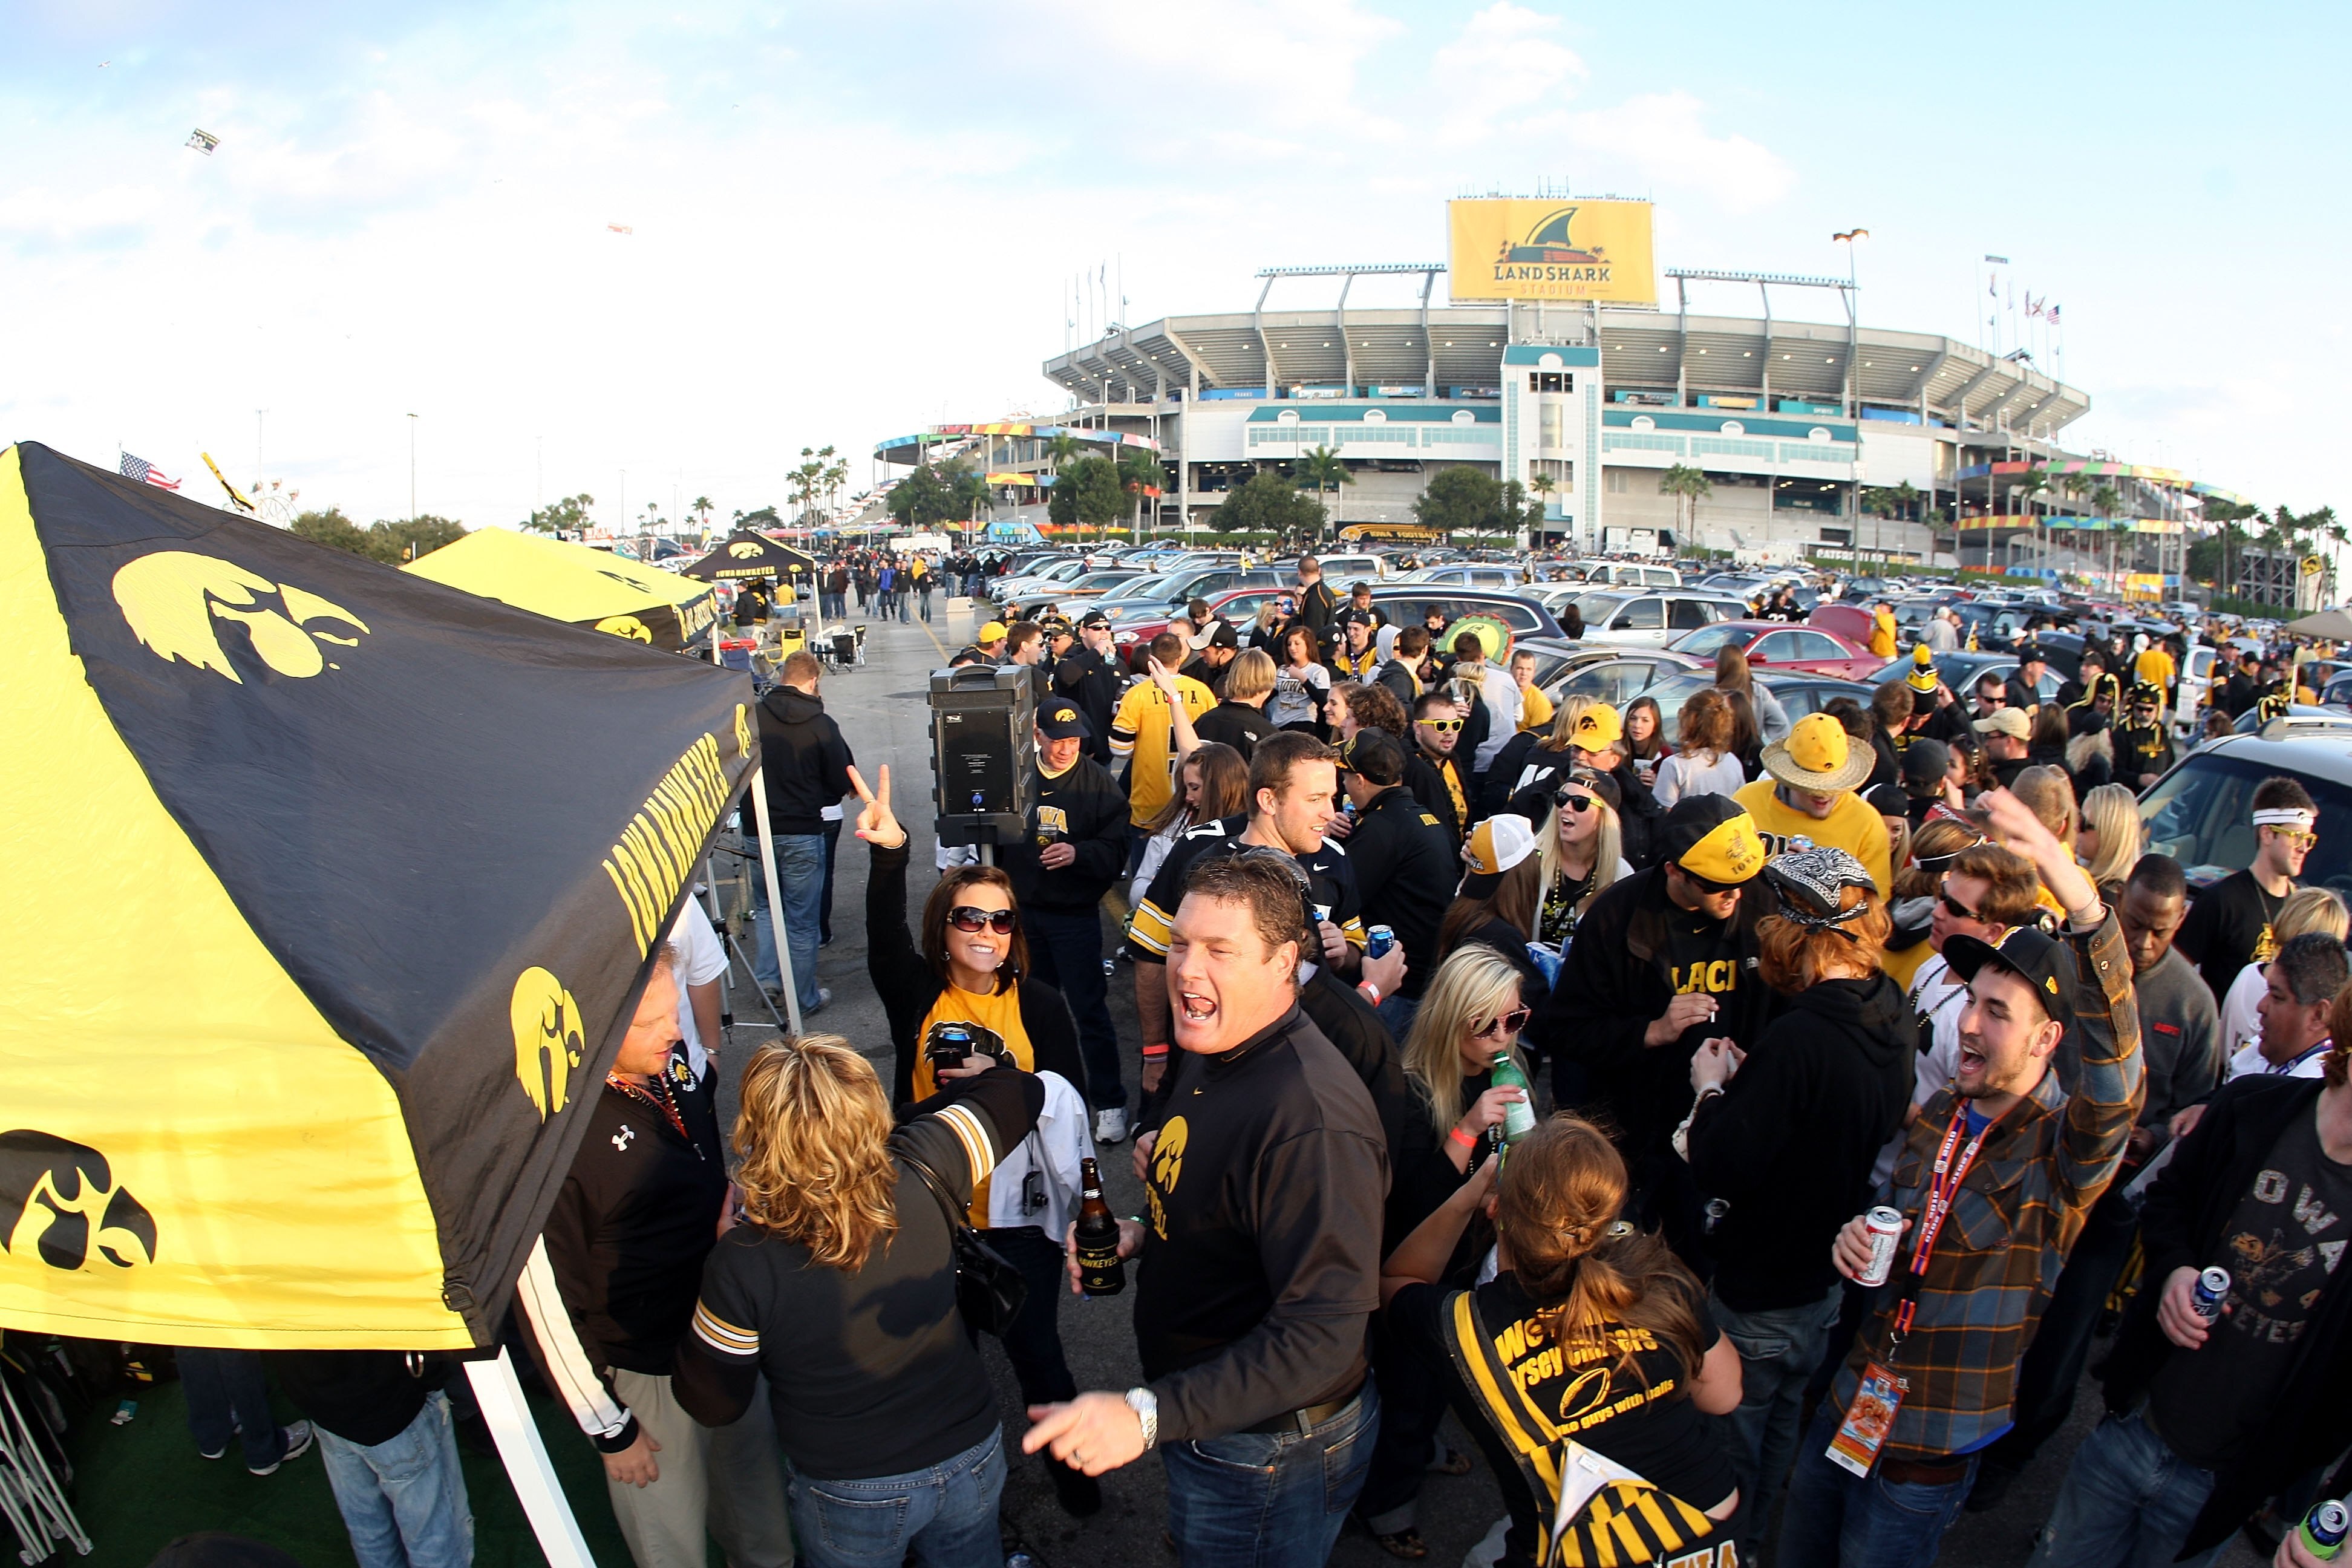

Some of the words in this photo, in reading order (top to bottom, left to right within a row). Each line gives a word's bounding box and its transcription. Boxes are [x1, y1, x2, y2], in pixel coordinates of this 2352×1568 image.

[1494, 265, 1612, 282] LANDSHARK
[1520, 284, 1586, 296] STADIUM
[1152, 690, 1198, 705] IOA
[1579, 1405, 1615, 1429] guys
[1613, 1393, 1645, 1414] with
